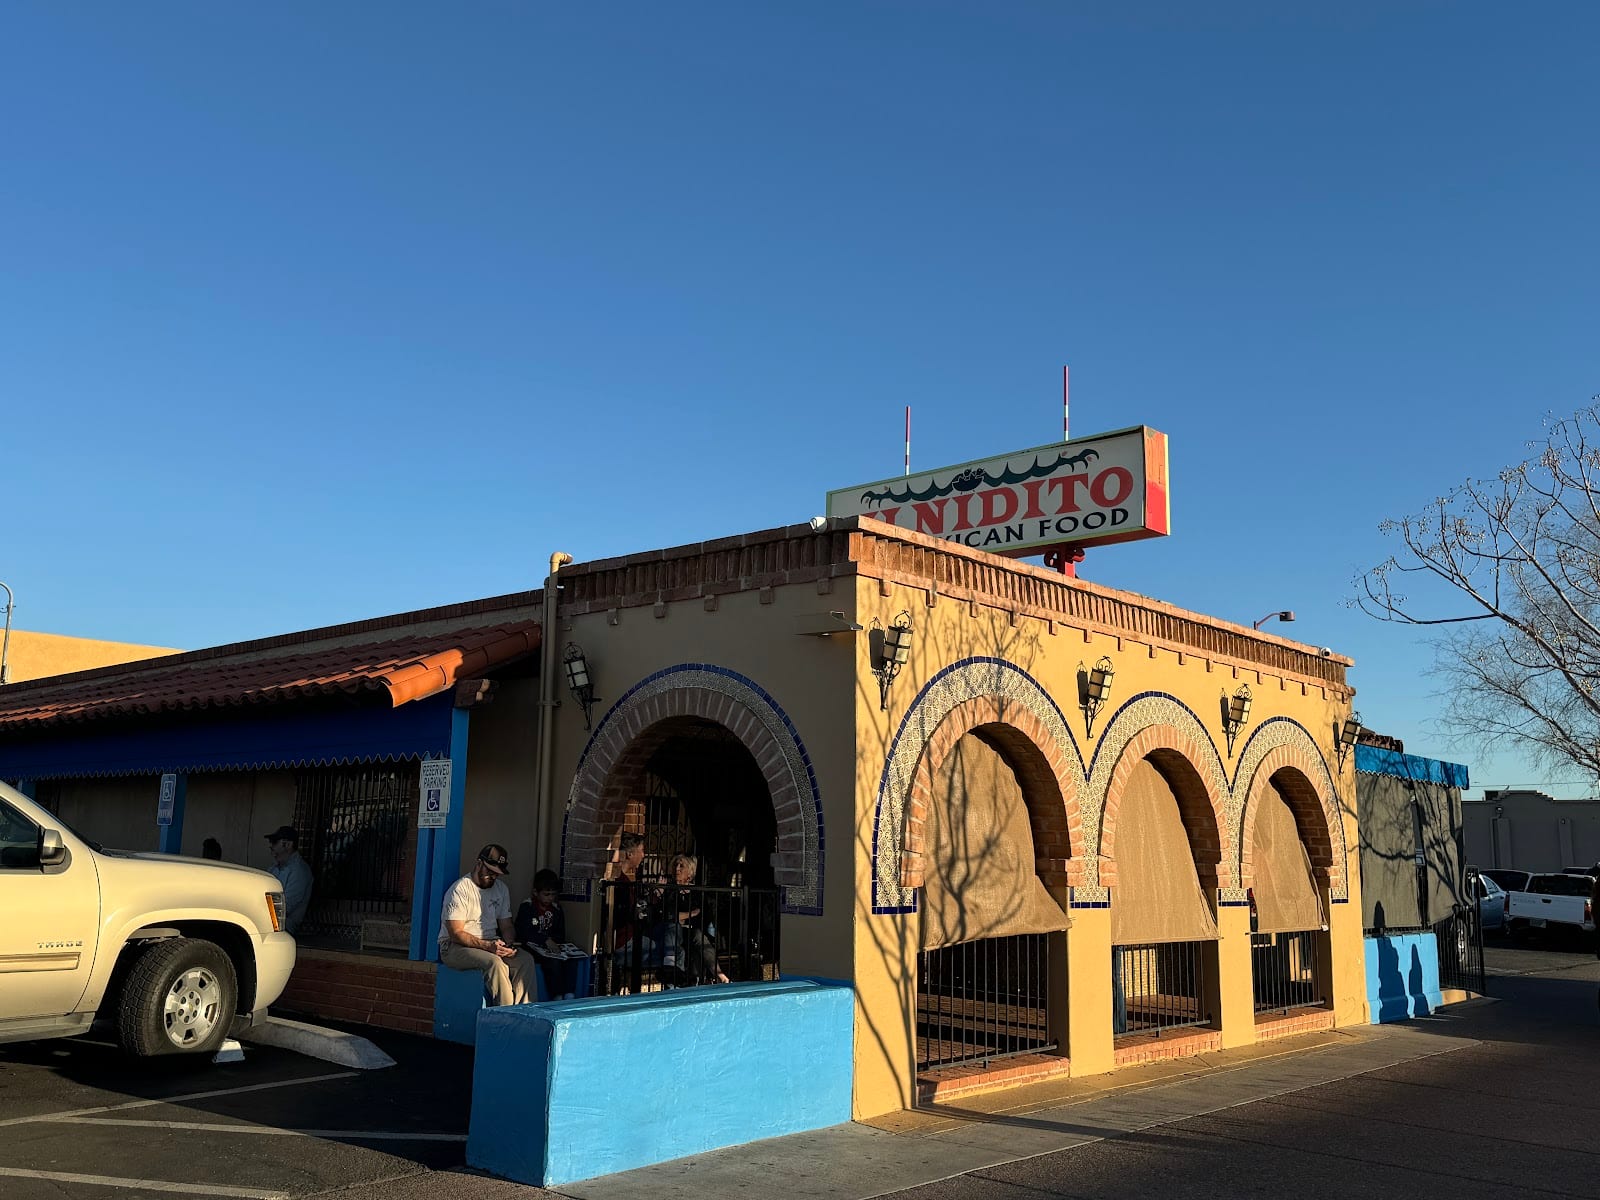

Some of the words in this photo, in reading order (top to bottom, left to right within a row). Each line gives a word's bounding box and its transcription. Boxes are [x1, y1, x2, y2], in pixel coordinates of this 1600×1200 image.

[912, 466, 1134, 534] NIDITO
[1039, 507, 1129, 537] FOOD
[423, 764, 449, 776] RESERVED
[424, 777, 446, 788] PARKING
